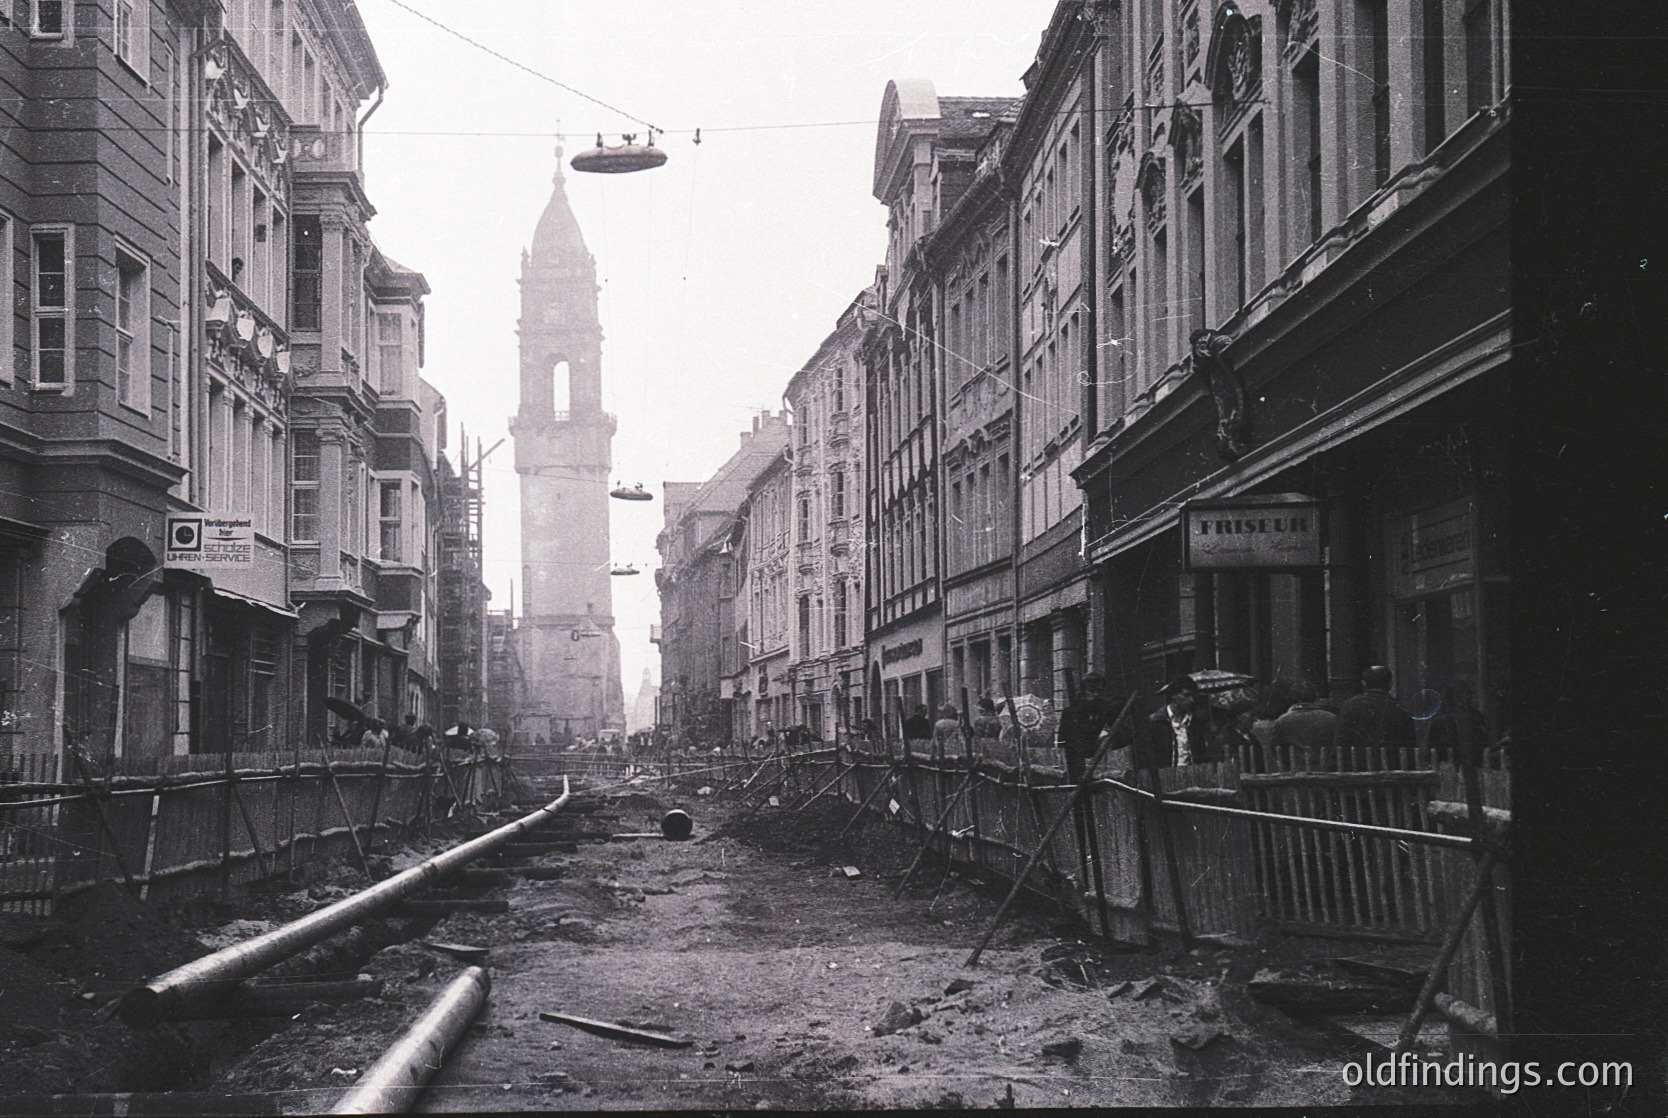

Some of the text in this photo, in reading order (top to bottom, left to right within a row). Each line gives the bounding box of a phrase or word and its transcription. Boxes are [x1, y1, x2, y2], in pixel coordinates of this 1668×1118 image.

[204, 518, 251, 529] Vorübergehend
[1201, 518, 1308, 535] FRISEUR
[219, 528, 233, 536] hier
[166, 553, 251, 562] UHREN-SERVICE
